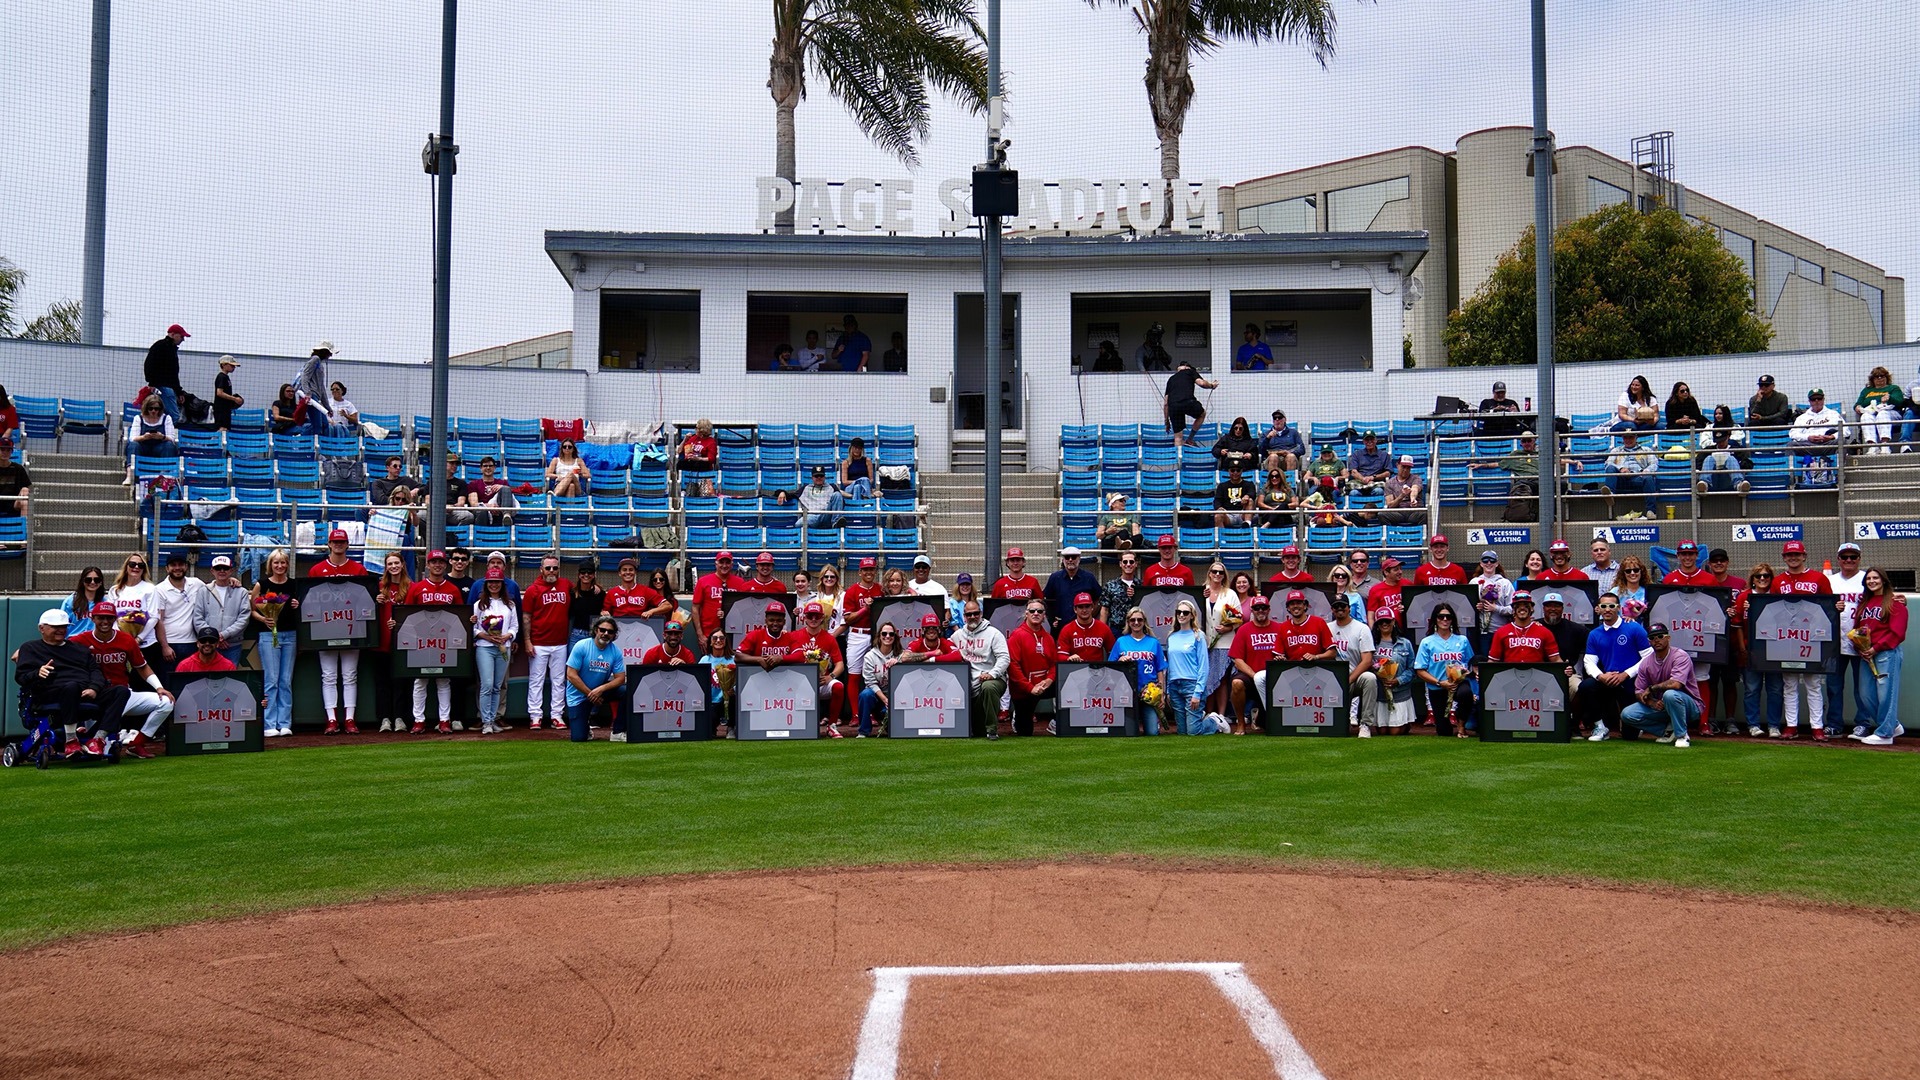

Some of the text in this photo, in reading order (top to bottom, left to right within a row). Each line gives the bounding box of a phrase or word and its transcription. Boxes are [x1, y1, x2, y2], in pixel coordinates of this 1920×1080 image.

[756, 177, 1221, 232] PAGE SADIUM
[1756, 525, 1799, 533] ACCESSIBLE
[1880, 523, 1920, 531] ACCESSIBL
[1156, 576, 1184, 586] LIONS
[1005, 588, 1032, 599] LIONS
[1780, 582, 1818, 595] LIONS
[116, 599, 142, 608] IONS
[422, 592, 453, 604] LIONS
[542, 592, 566, 605] LMU
[615, 596, 646, 607] LIONS
[324, 610, 354, 623] LMU
[1156, 617, 1173, 627] LM
[347, 624, 353, 635] 7
[1672, 619, 1703, 632] LMU
[1287, 634, 1317, 647] LIONS
[1693, 635, 1704, 647] 25
[1777, 628, 1810, 642] LMU
[418, 638, 447, 650] LMU
[958, 638, 984, 650] LMU
[1073, 637, 1103, 649] LIONS
[1509, 637, 1541, 649] LIONS
[623, 648, 642, 658] MU
[762, 646, 790, 656] LIONS
[1434, 652, 1462, 662] LIONS
[1799, 645, 1812, 658] 27
[92, 652, 127, 664] IONS
[440, 653, 446, 664] 8
[589, 660, 610, 670] LIONS
[1143, 664, 1153, 674] 29
[654, 700, 684, 713] LMU
[764, 699, 794, 712] LMU
[914, 697, 944, 710] LMU
[1083, 697, 1112, 710] LMU
[1293, 696, 1323, 708] LMU
[1509, 699, 1540, 712] LMU
[197, 709, 232, 722] LMU
[676, 715, 682, 728] 4
[786, 713, 793, 726] 0
[938, 713, 945, 725] 6
[1102, 712, 1114, 725] 29
[1313, 711, 1325, 724] 36
[1528, 714, 1540, 728] 42
[224, 725, 231, 738] 3
